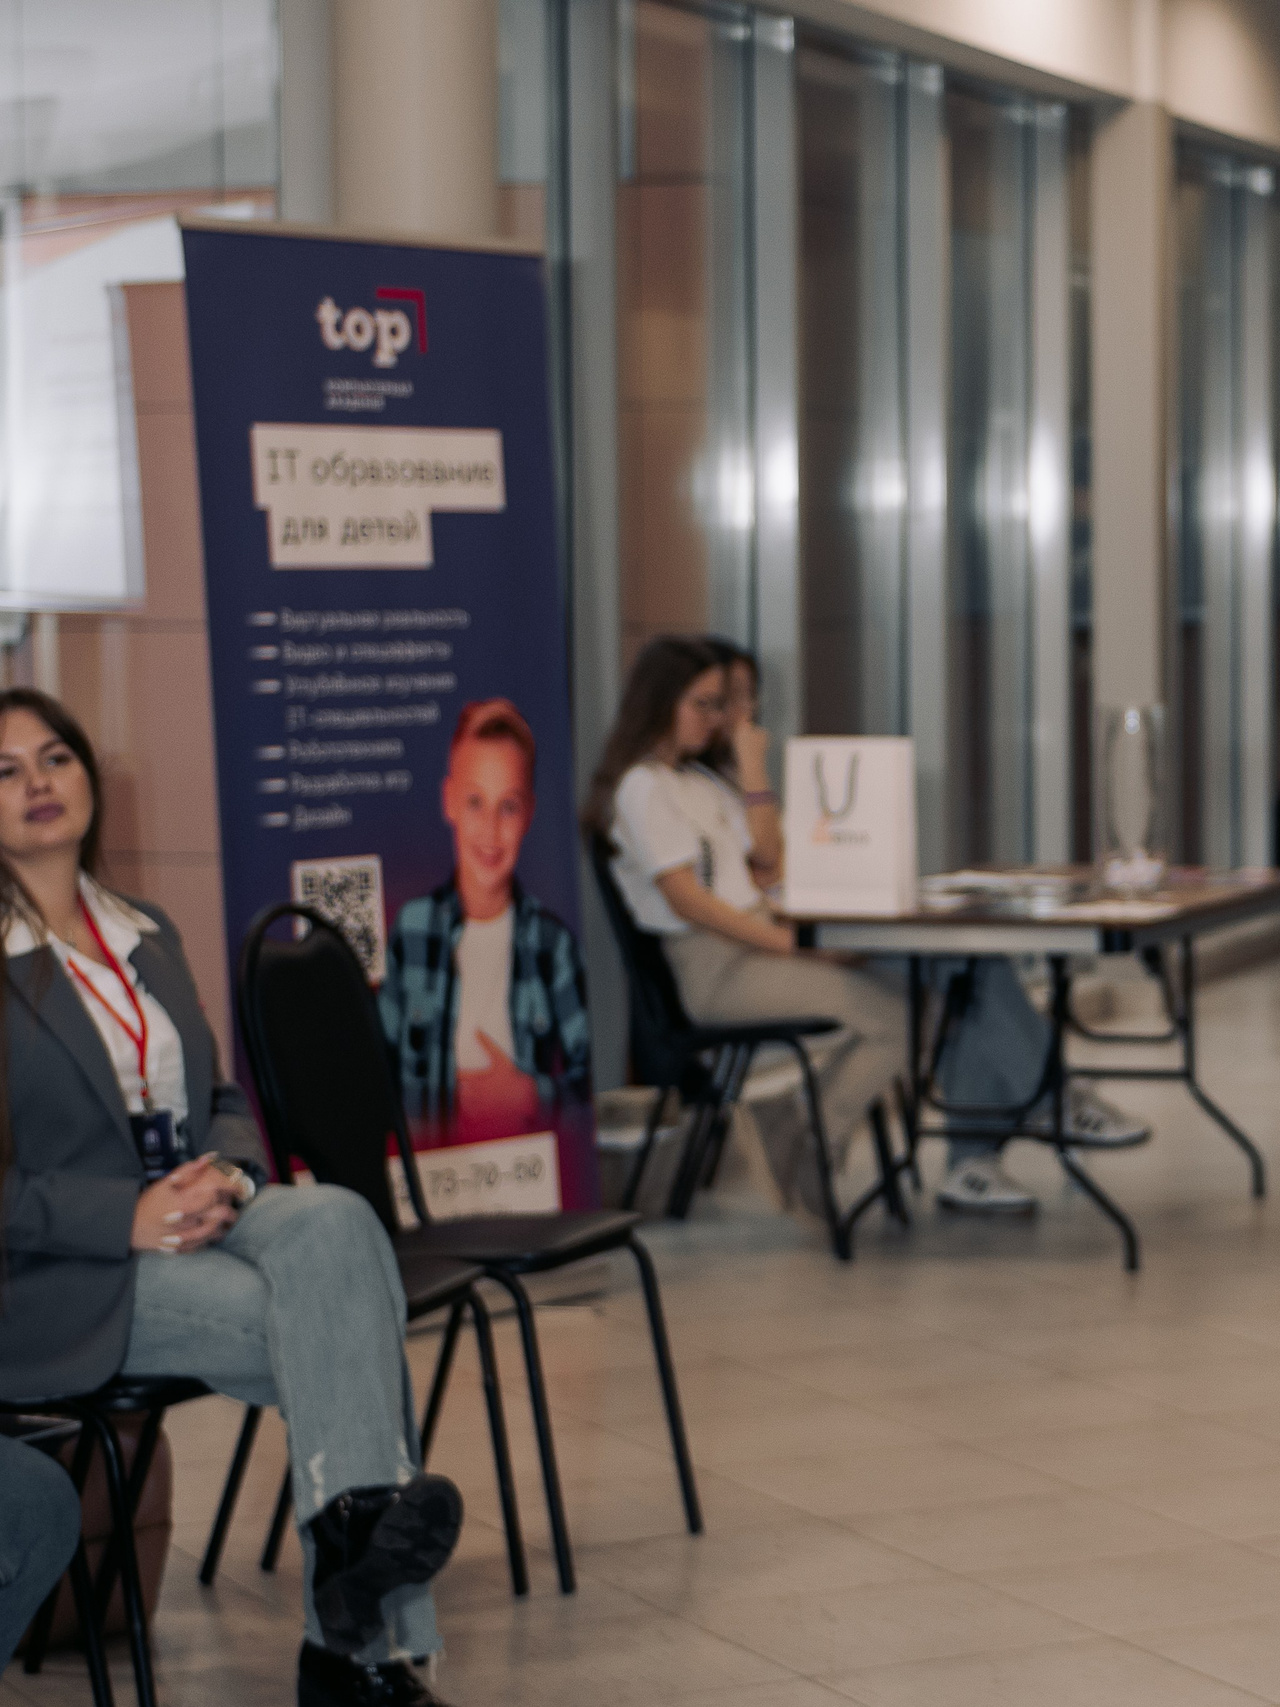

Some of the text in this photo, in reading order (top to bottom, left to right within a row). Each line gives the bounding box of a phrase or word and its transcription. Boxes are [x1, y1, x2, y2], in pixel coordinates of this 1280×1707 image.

[316, 296, 412, 368] top
[266, 447, 495, 489] IT образование
[281, 512, 421, 546] для детей
